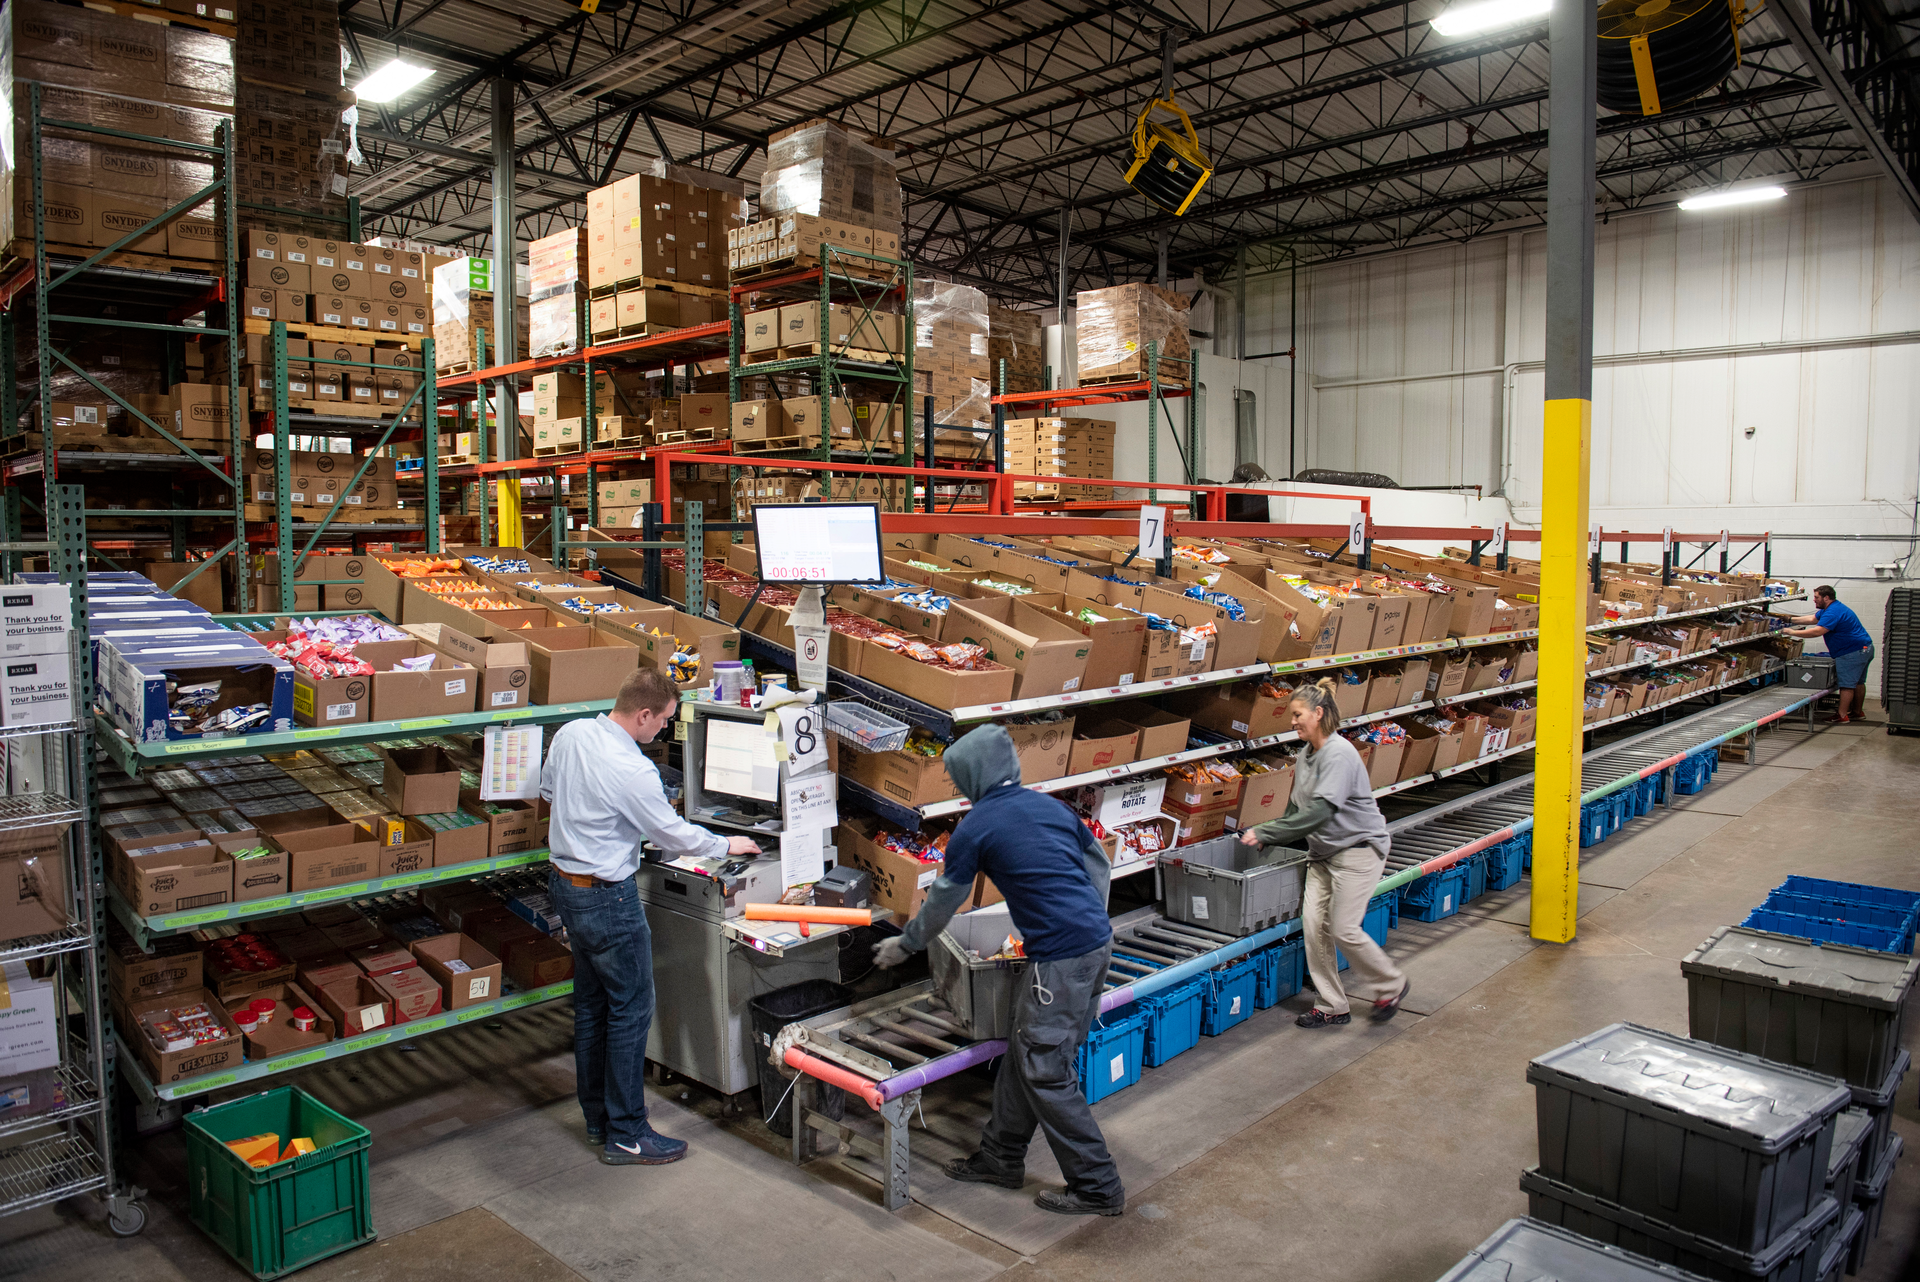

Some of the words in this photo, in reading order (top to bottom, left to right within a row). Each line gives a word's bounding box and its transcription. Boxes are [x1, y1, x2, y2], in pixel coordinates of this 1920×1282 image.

[25, 22, 80, 40] SNYDER'S
[103, 40, 154, 57] SNYDER'S
[27, 85, 80, 101] SYDER'S
[104, 156, 154, 173] SNYDER'S
[26, 203, 80, 220] SYDER'S
[1146, 518, 1158, 548] 7
[1354, 522, 1362, 546] 6
[1494, 526, 1502, 546] 5
[1592, 530, 1598, 547] 4
[768, 567, 826, 578] -00:06:51
[34, 616, 48, 624] you
[954, 610, 976, 625] VENDING
[983, 626, 1018, 648] FOODSERVICE
[450, 636, 458, 646] THIS
[459, 640, 468, 650] SIDE
[10, 685, 35, 693] Thank
[38, 684, 52, 693] you
[10, 696, 28, 705] your
[32, 693, 70, 702] business.
[794, 716, 816, 754] 8
[790, 786, 815, 796] ABSOUTLEY
[1122, 796, 1146, 808] ROTATE
[503, 828, 527, 838] STRIDE
[1140, 836, 1157, 846] BBQ
[394, 854, 419, 865] Juicy
[396, 862, 419, 873] Fruit
[154, 876, 175, 885] Juicy
[246, 876, 278, 887] DOUBLEMINT
[139, 972, 157, 986] LIFE
[156, 968, 188, 981] SAVERS
[470, 980, 486, 995] 59
[13, 1007, 36, 1016] Green
[223, 1038, 240, 1046] 22935
[178, 1060, 198, 1073] LIFE
[198, 1052, 228, 1066] SAVERS
